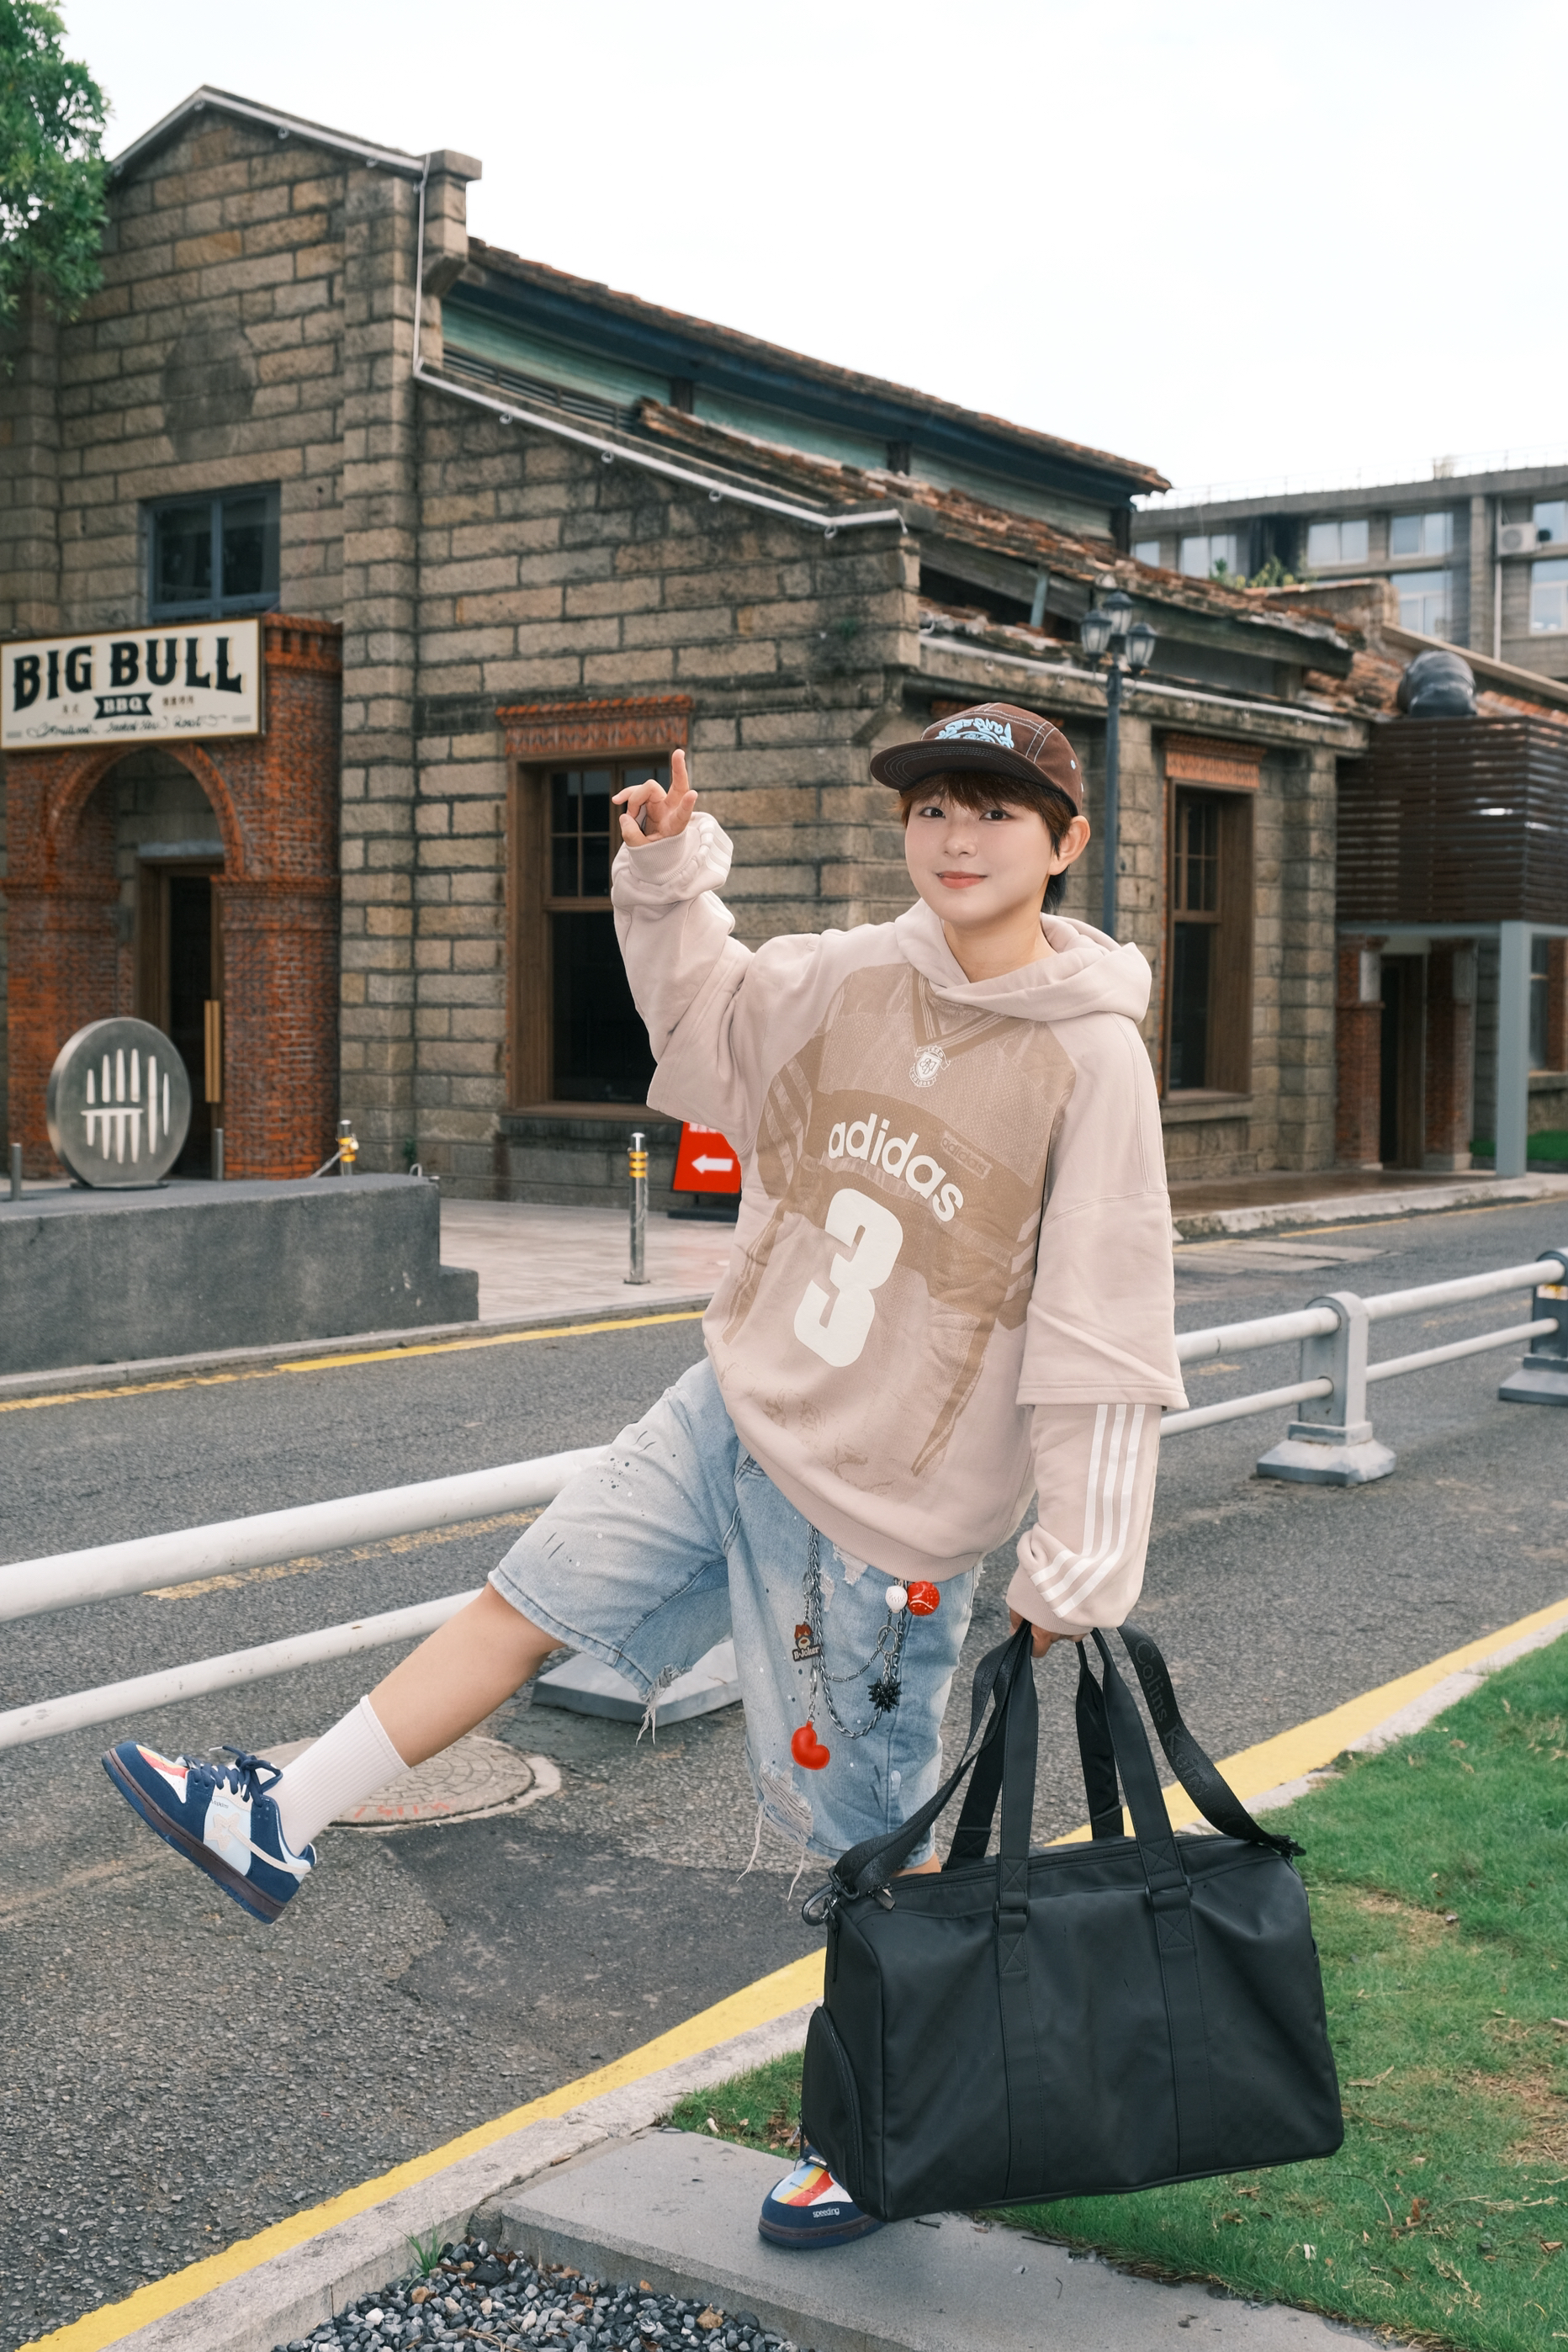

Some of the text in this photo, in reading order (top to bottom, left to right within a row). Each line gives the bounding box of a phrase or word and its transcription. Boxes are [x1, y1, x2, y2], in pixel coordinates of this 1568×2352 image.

[13, 637, 242, 712] BIG BULL
[103, 696, 143, 714] BBQ
[911, 1073, 931, 1085] adidas
[828, 1113, 964, 1222] adidas
[942, 1137, 987, 1175] adidas
[793, 1188, 903, 1368] 3
[1136, 1640, 1168, 1723] Colins
[813, 2207, 840, 2218] speeding
